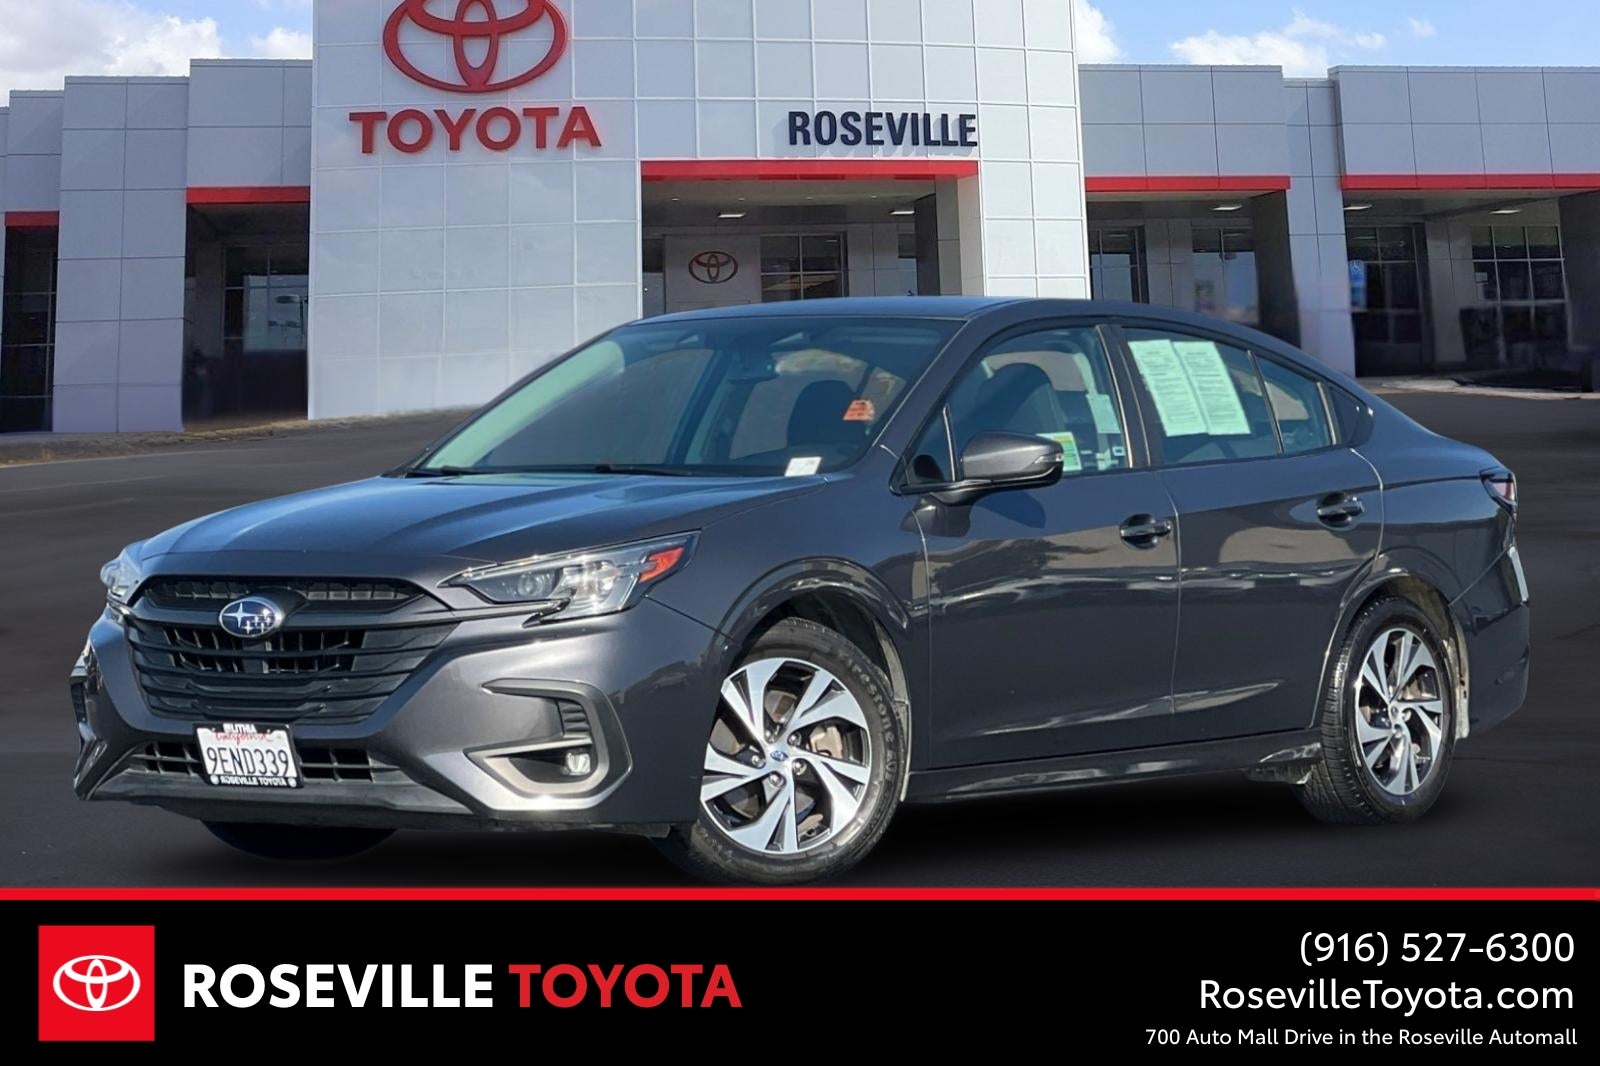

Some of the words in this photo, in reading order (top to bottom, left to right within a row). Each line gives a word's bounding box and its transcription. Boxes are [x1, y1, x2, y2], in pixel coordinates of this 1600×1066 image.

[349, 106, 602, 154] TOYOTA
[788, 110, 978, 147] ROSEVILLE
[207, 747, 289, 777] 9END339
[221, 776, 258, 786] ROSEVILLE
[259, 777, 287, 787] TOYOTA
